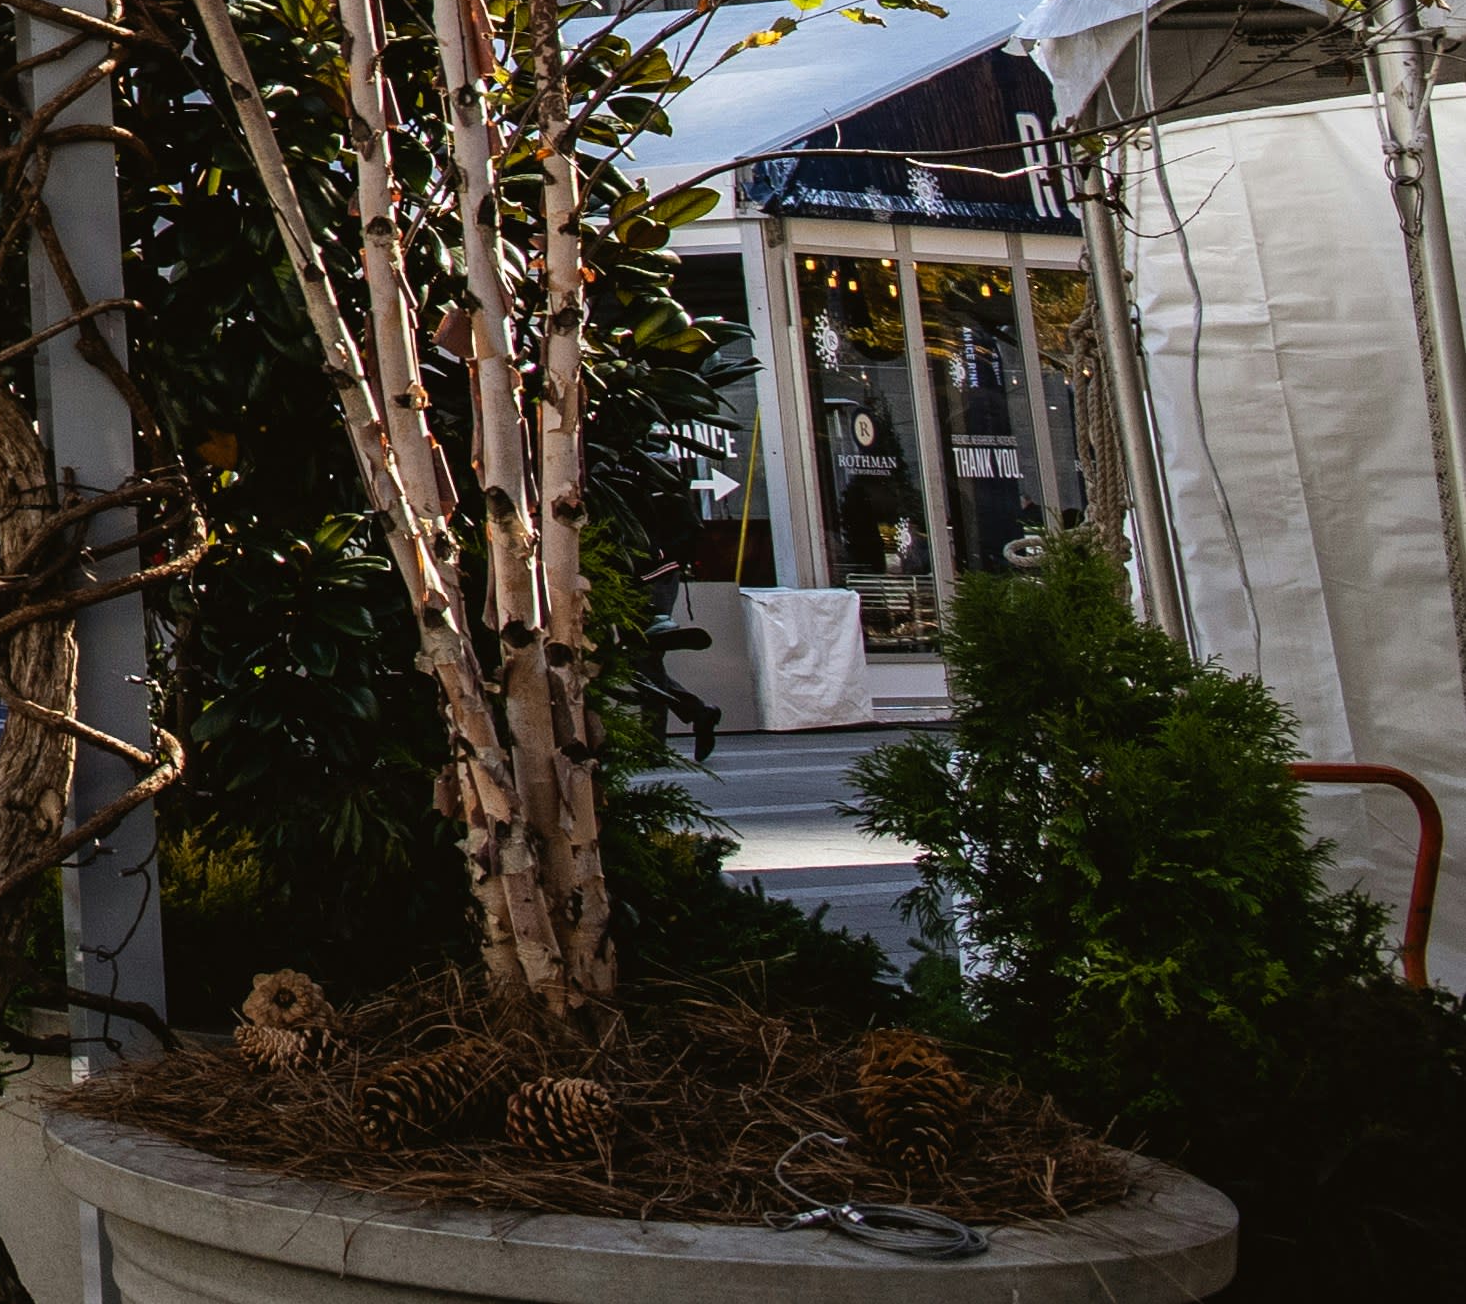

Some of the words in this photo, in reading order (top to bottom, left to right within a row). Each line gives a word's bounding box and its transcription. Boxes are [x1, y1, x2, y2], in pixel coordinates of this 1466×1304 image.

[838, 454, 897, 468] ROTHMAN
[952, 447, 994, 478] THANK
[994, 448, 1024, 478] YOU.
